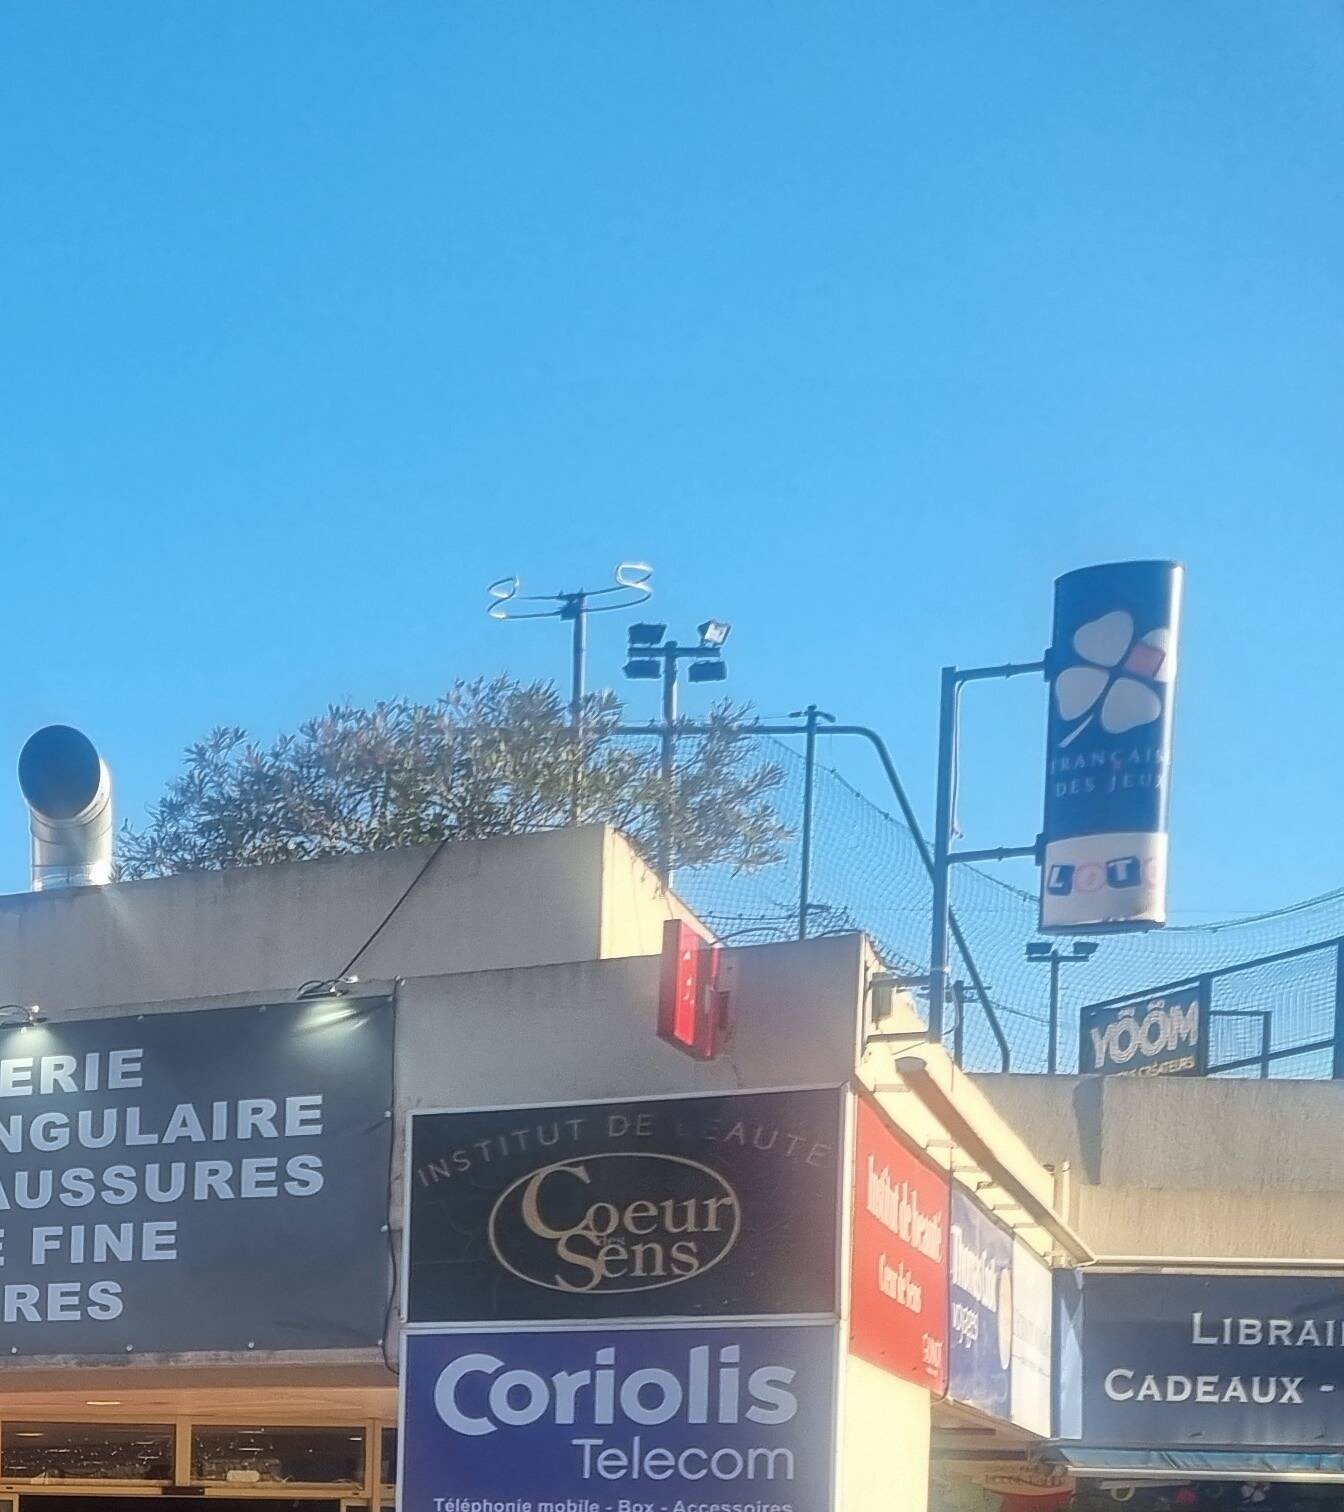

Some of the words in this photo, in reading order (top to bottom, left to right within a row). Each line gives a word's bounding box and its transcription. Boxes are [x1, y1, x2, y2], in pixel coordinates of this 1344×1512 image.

[1056, 777, 1096, 797] DES
[418, 1118, 584, 1188] INSTITUT
[608, 1114, 653, 1137] DE
[521, 1165, 732, 1239] Coeur
[32, 1221, 178, 1265] FINE
[555, 1231, 699, 1291] Sens
[433, 1344, 799, 1437] Coriolis
[1104, 1368, 1305, 1404] CADEAUX
[571, 1436, 794, 1481] Telecom
